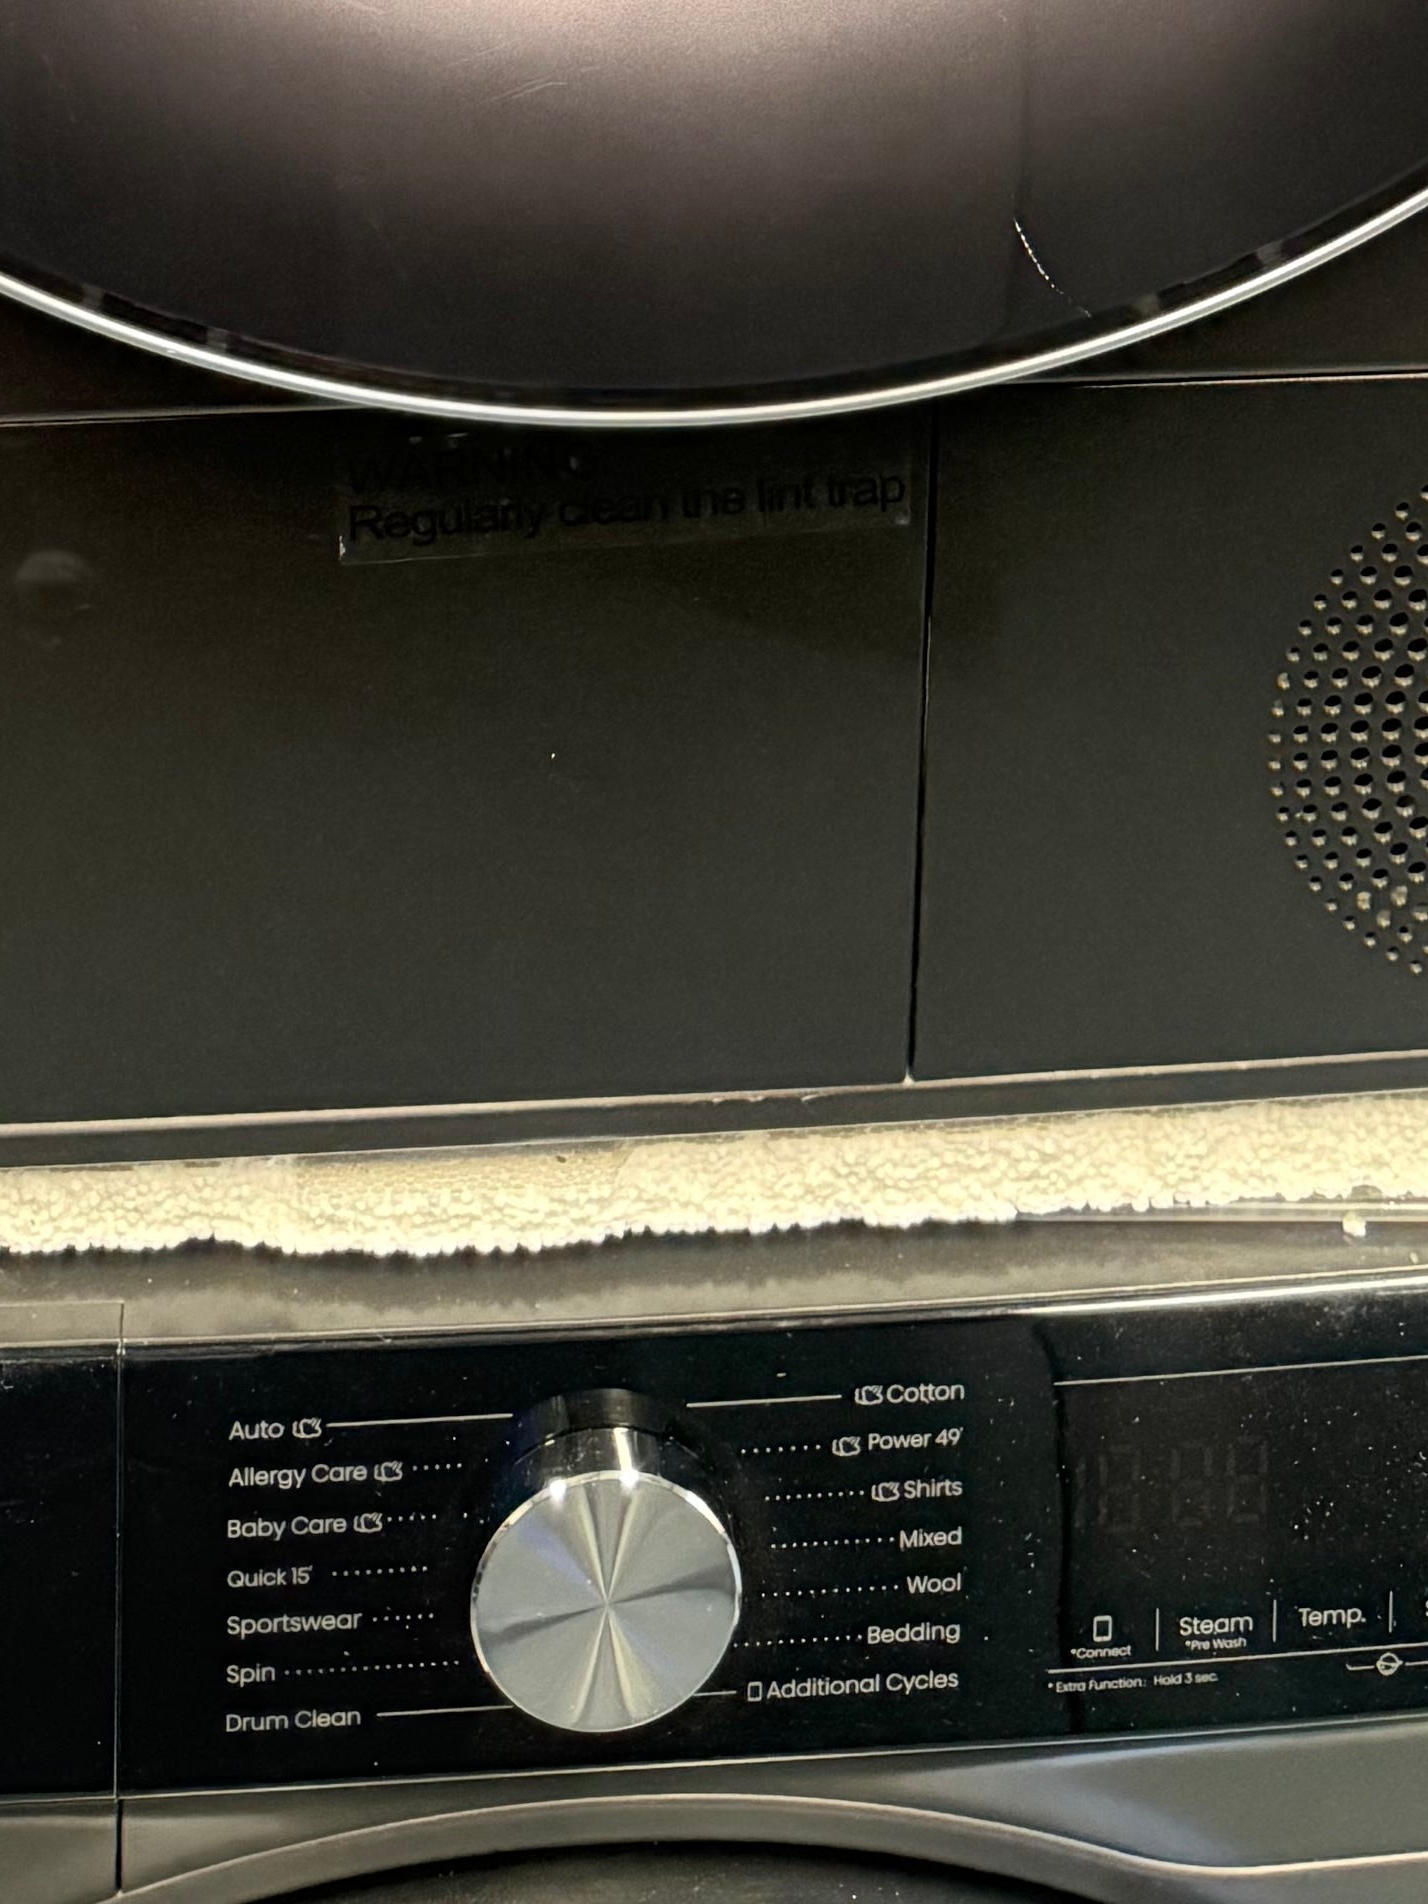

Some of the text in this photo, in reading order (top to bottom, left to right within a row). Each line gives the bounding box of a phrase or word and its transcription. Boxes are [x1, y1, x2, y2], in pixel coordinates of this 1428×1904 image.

[886, 1383, 965, 1404] Cotton
[228, 1420, 285, 1441] Auto
[868, 1431, 932, 1450] Power
[228, 1464, 368, 1489] Allergy Care
[903, 1479, 963, 1499] Shirts
[227, 1515, 347, 1541] Baby Care
[899, 1526, 962, 1550] Mixed
[227, 1568, 287, 1588] Quick
[907, 1572, 961, 1593] Wool
[226, 1612, 363, 1639] Sportswear
[1179, 1615, 1253, 1636] Steam
[1298, 1607, 1367, 1629] Temp.
[867, 1621, 961, 1645] Bedding
[226, 1664, 275, 1687] Spin
[767, 1671, 959, 1699] Additional Cycles
[225, 1709, 361, 1733] Drum Clean
